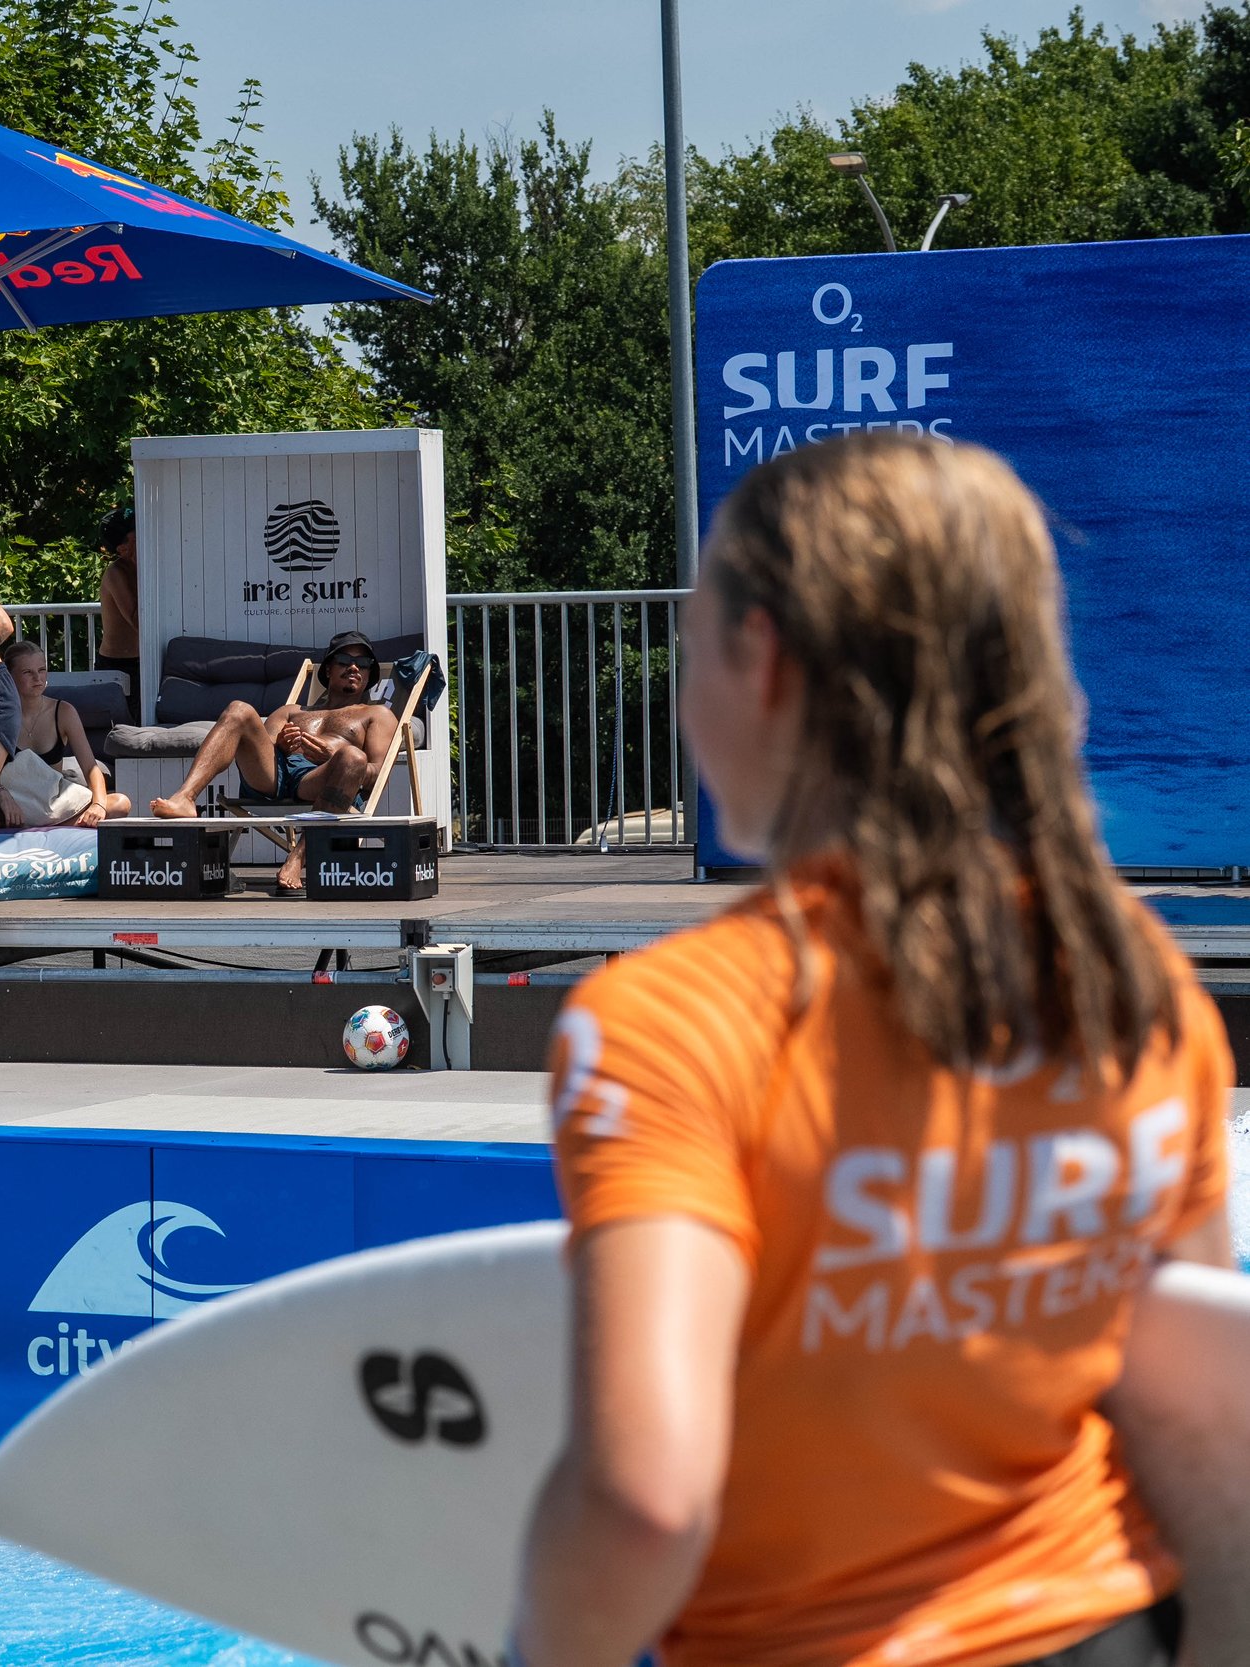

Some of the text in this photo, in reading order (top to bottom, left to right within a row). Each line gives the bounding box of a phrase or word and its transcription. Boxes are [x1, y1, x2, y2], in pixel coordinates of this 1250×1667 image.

[722, 342, 954, 420] SURF
[243, 577, 368, 604] irie surf.
[284, 607, 315, 615] COFFEE
[318, 606, 336, 614] AND
[813, 1097, 1189, 1273] SURF
